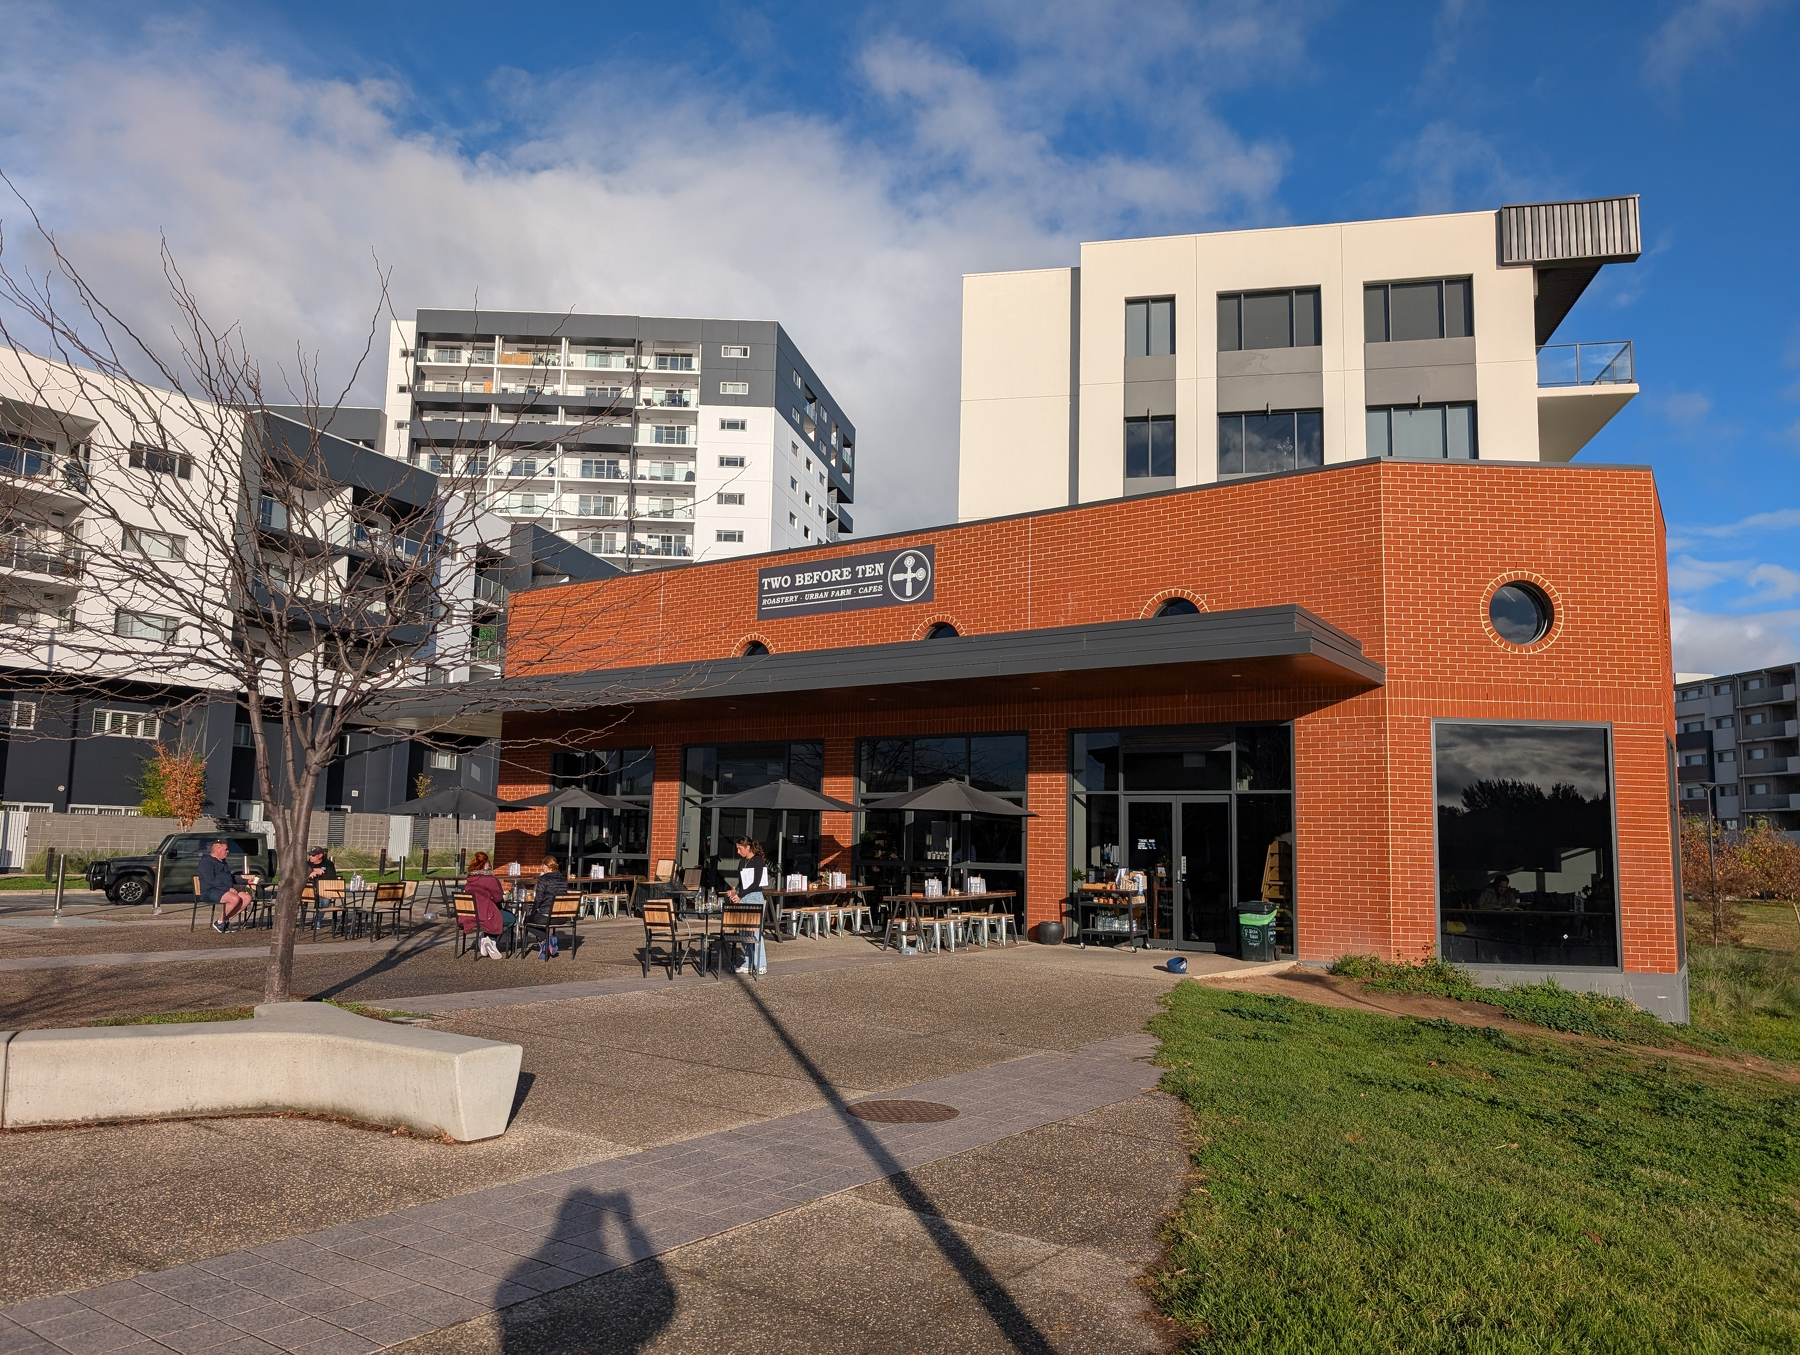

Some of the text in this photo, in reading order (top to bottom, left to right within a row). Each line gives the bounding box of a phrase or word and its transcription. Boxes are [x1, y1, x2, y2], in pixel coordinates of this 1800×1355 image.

[762, 563, 884, 590] TWO BEFORE TEN
[762, 585, 883, 605] ROASTERY URBAN FARM CAFES
